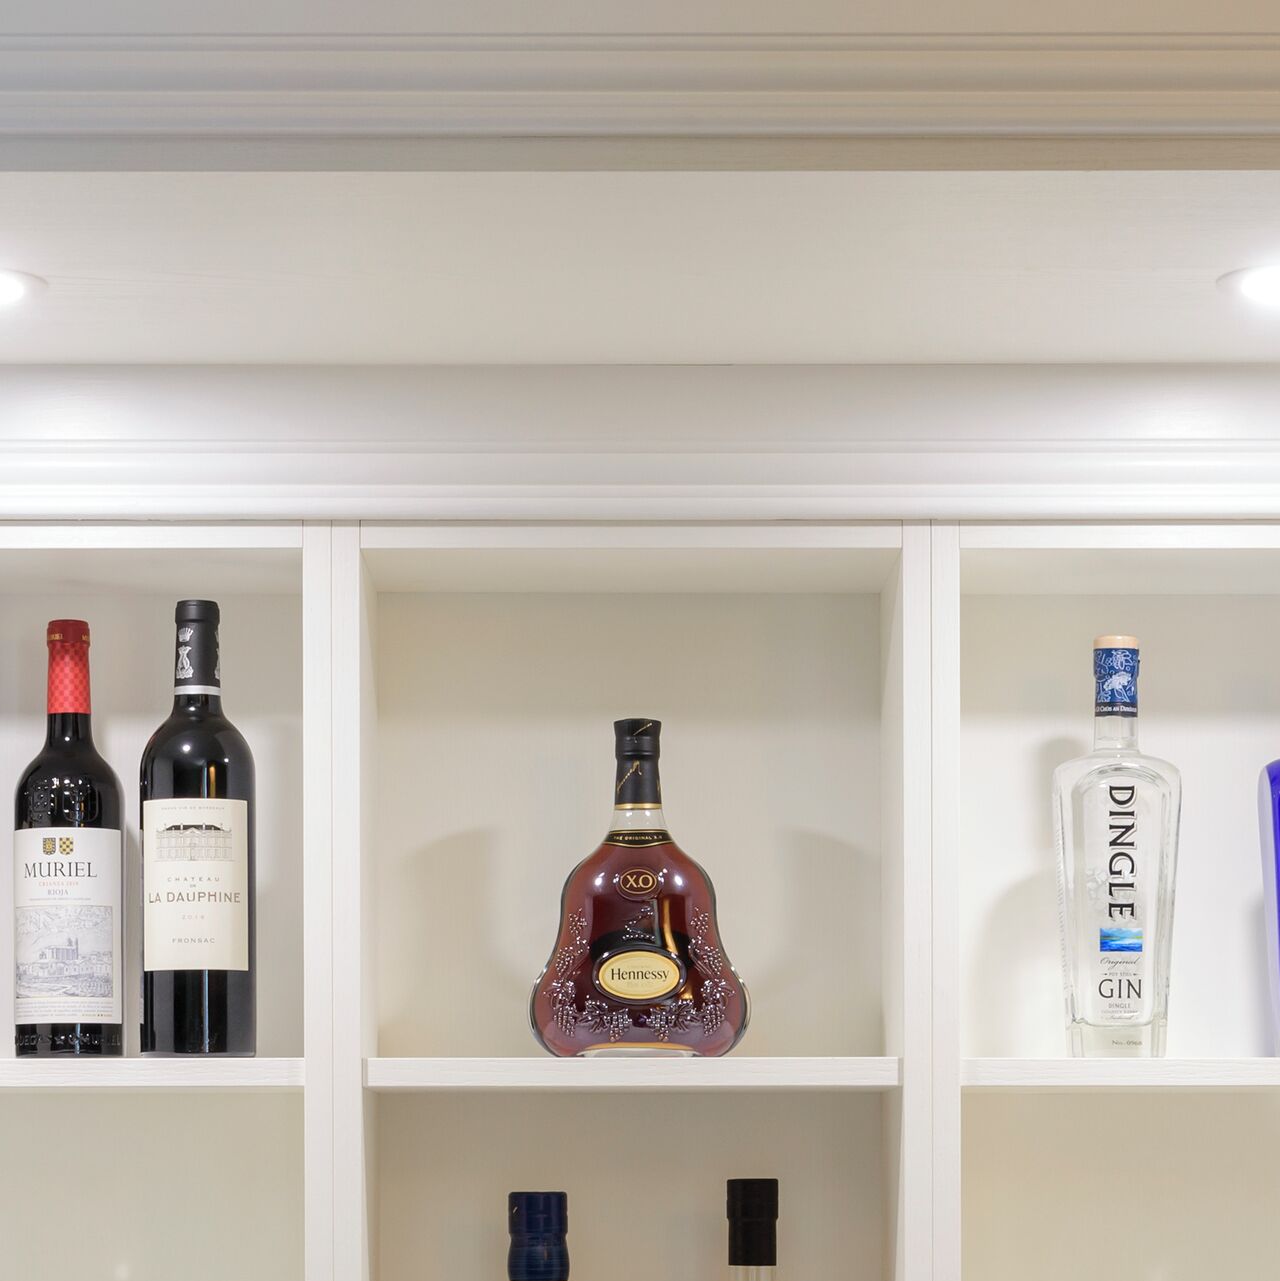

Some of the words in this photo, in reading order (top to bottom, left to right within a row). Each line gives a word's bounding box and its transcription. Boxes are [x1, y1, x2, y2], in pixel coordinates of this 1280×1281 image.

[1109, 785, 1136, 920] DINGLE
[24, 861, 98, 879] MURIEL
[149, 893, 163, 904] LA
[167, 891, 241, 904] DAUPHINE
[611, 967, 669, 982] Hennessy
[1099, 979, 1142, 999] GIN
